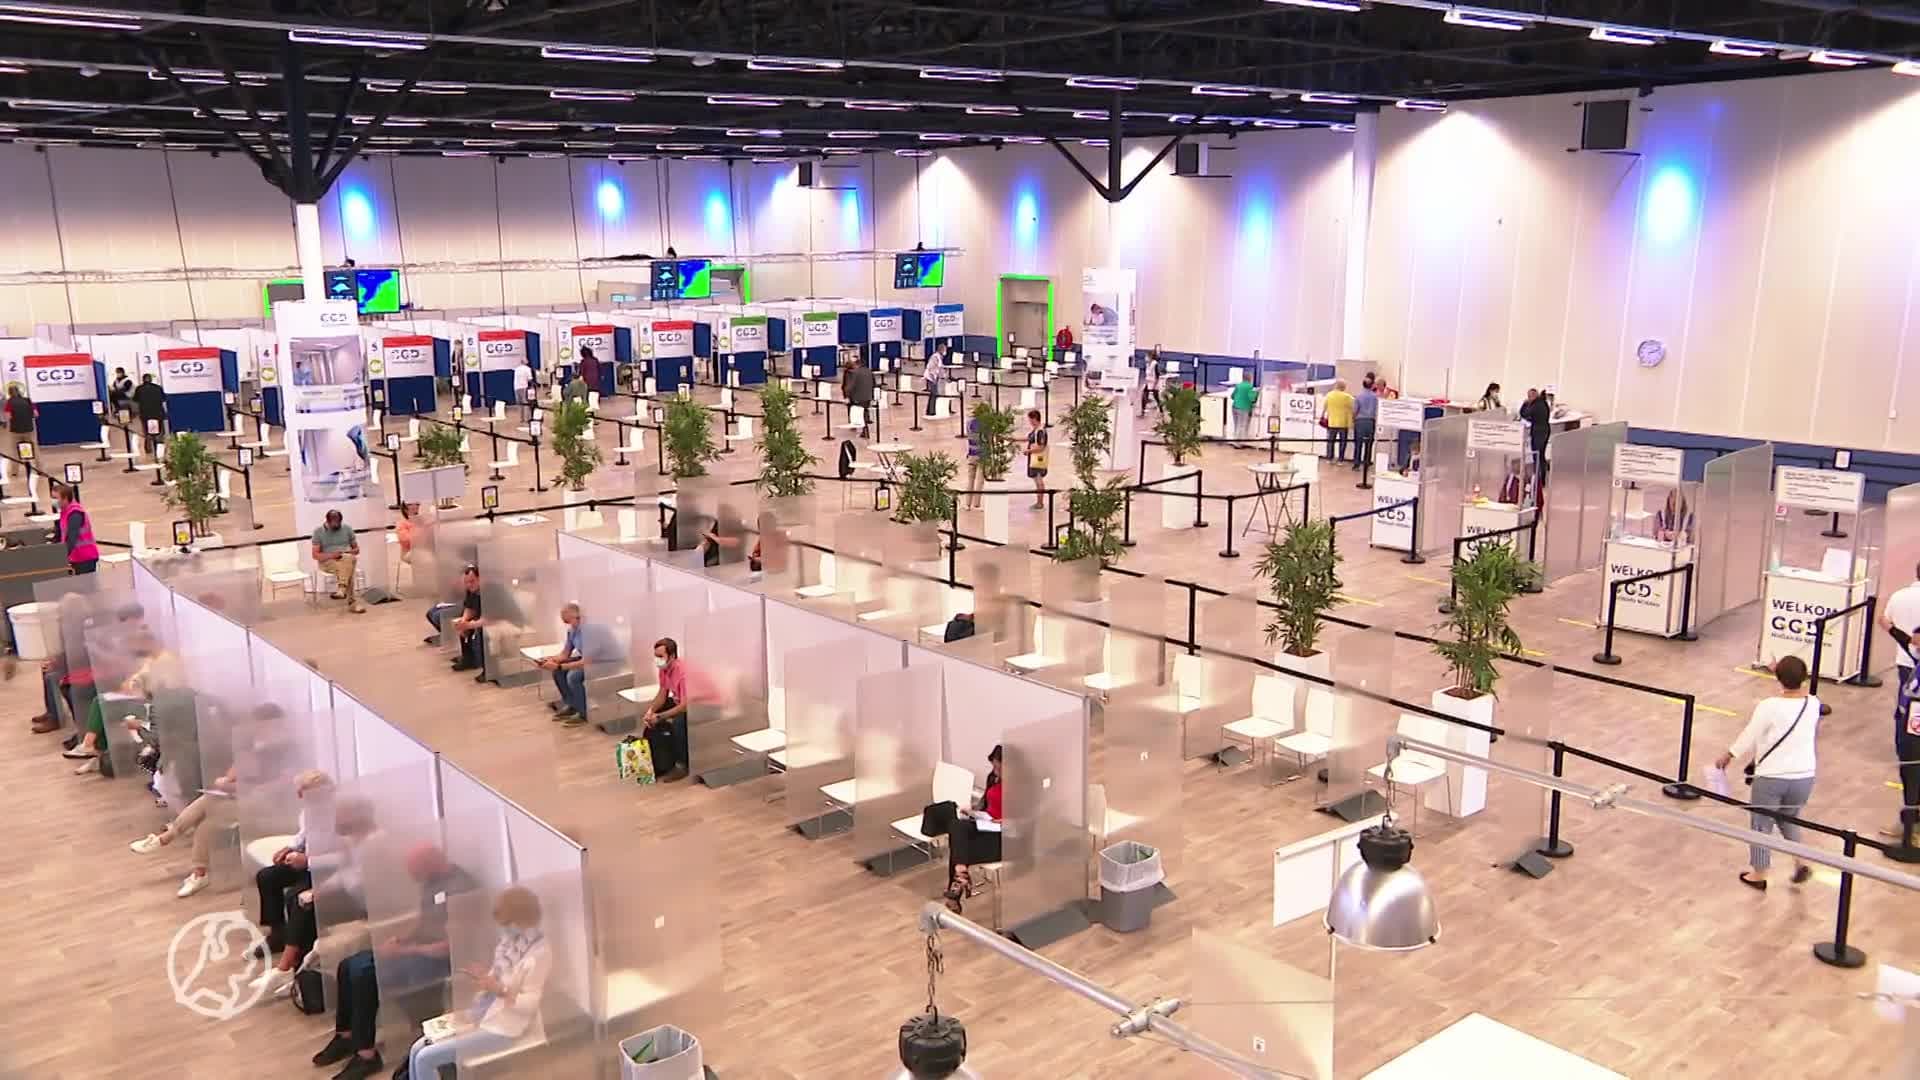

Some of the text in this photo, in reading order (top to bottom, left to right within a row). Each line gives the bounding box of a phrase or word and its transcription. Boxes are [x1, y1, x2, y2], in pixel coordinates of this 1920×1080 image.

[144, 355, 153, 365] 3
[8, 361, 17, 372] 2
[36, 369, 76, 382] GGD
